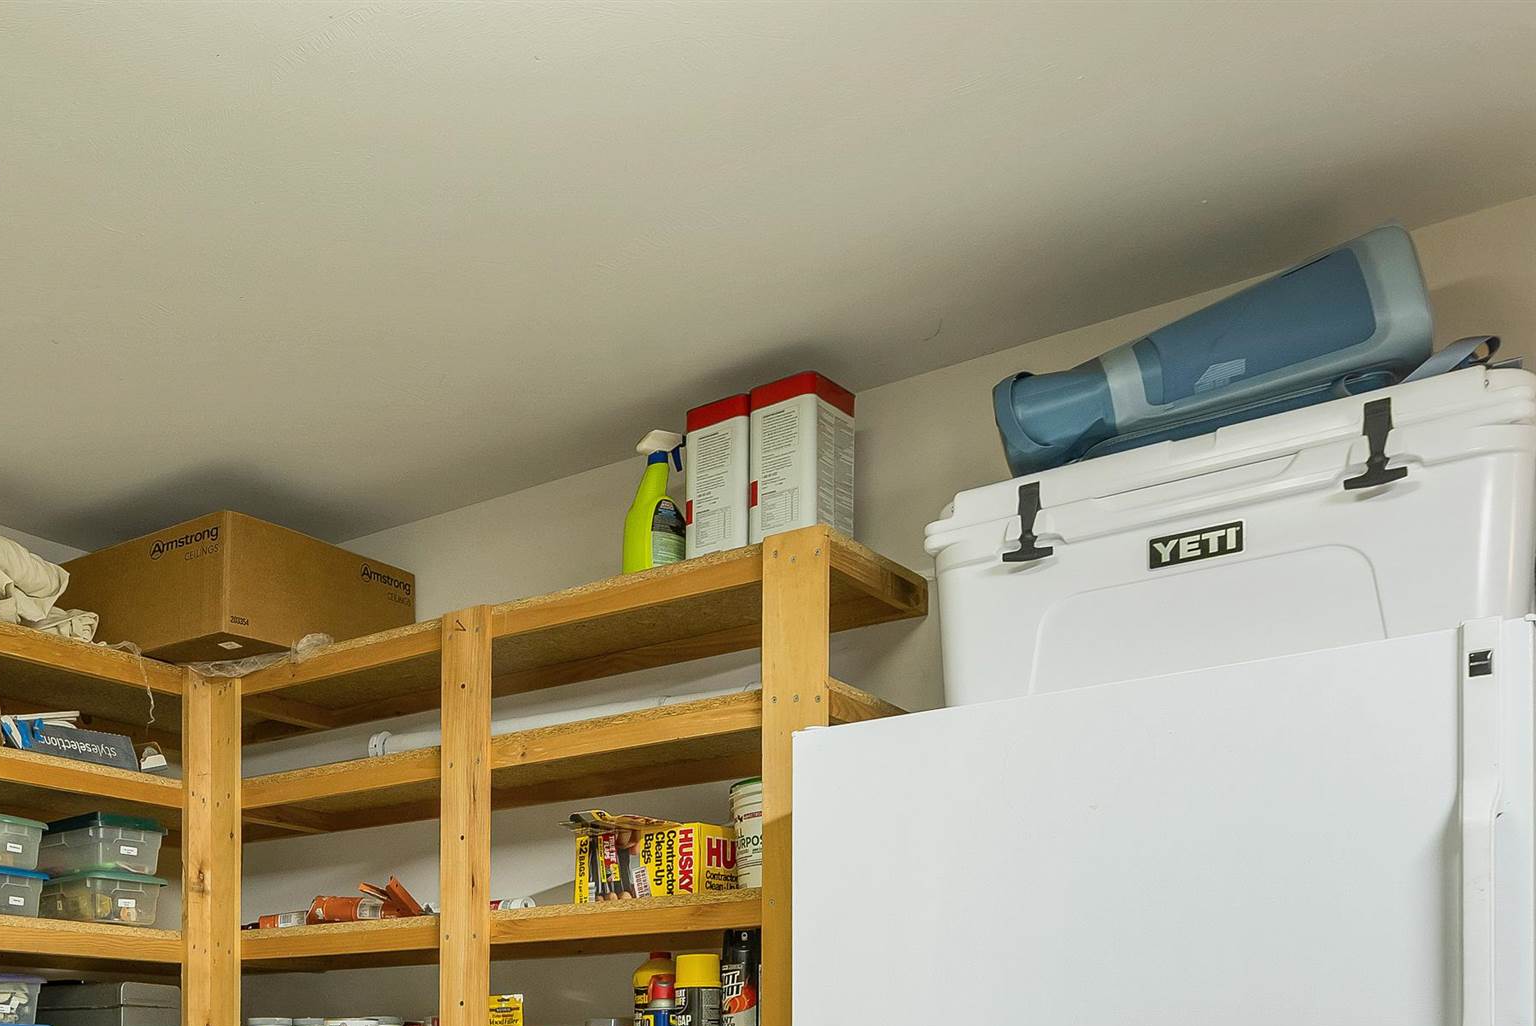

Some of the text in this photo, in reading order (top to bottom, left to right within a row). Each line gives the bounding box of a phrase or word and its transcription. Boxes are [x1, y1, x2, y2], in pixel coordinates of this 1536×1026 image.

[149, 526, 219, 560] Armstrong
[184, 543, 219, 561] CEILINGS
[1153, 527, 1237, 563] YETI
[360, 563, 411, 596] Armstrong
[579, 839, 588, 855] 32
[641, 833, 654, 864] Bags
[666, 830, 676, 895] Contractor
[679, 828, 694, 893] HUSKY
[578, 856, 586, 877] BAGS
[677, 1015, 691, 1026] GAP
